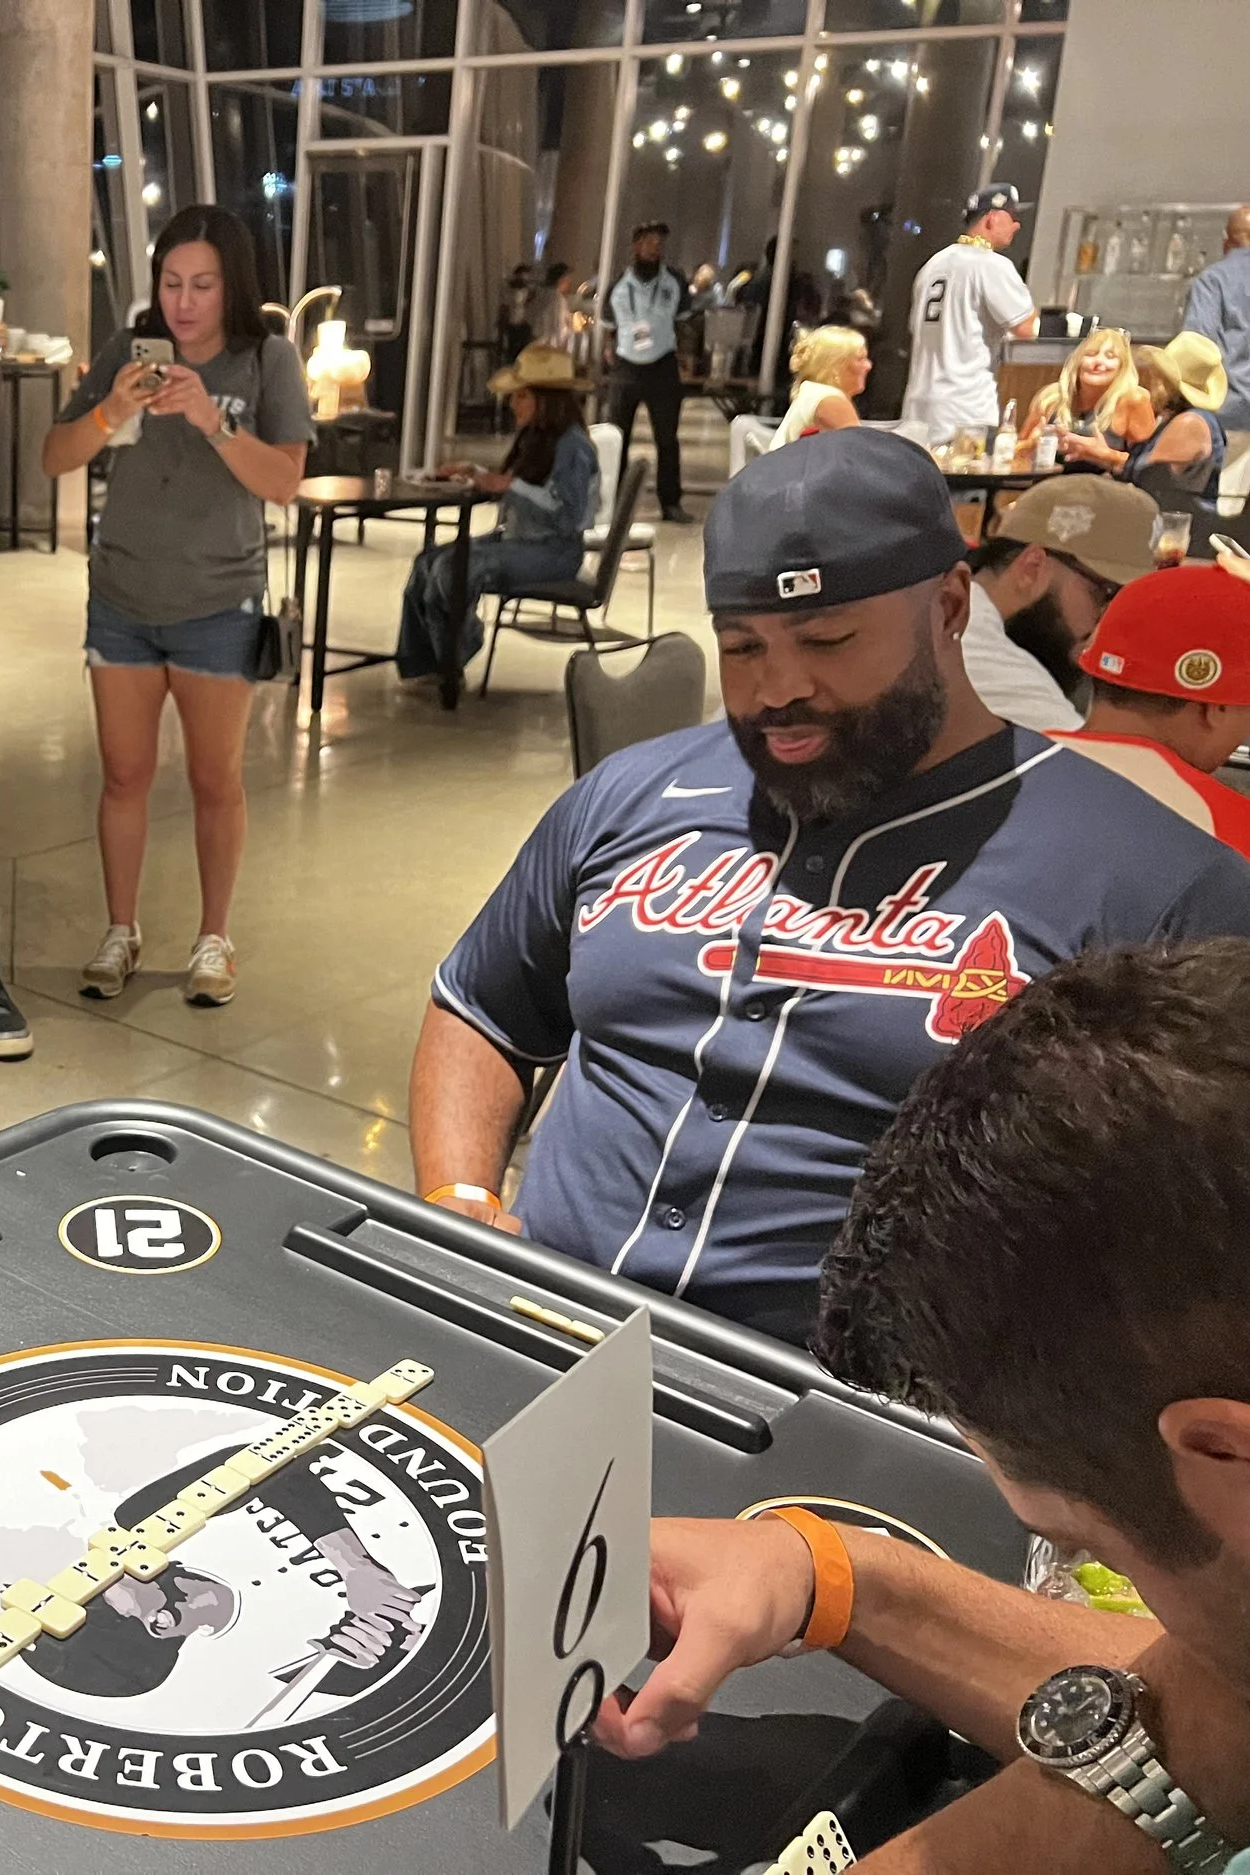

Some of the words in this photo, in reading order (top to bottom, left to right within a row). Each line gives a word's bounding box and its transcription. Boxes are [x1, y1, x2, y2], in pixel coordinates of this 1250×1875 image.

[924, 279, 948, 322] 2
[578, 830, 966, 956] Atlanta
[94, 1208, 186, 1258] 21
[165, 1363, 489, 1566] FOUNDTION
[553, 1457, 607, 1660] 6
